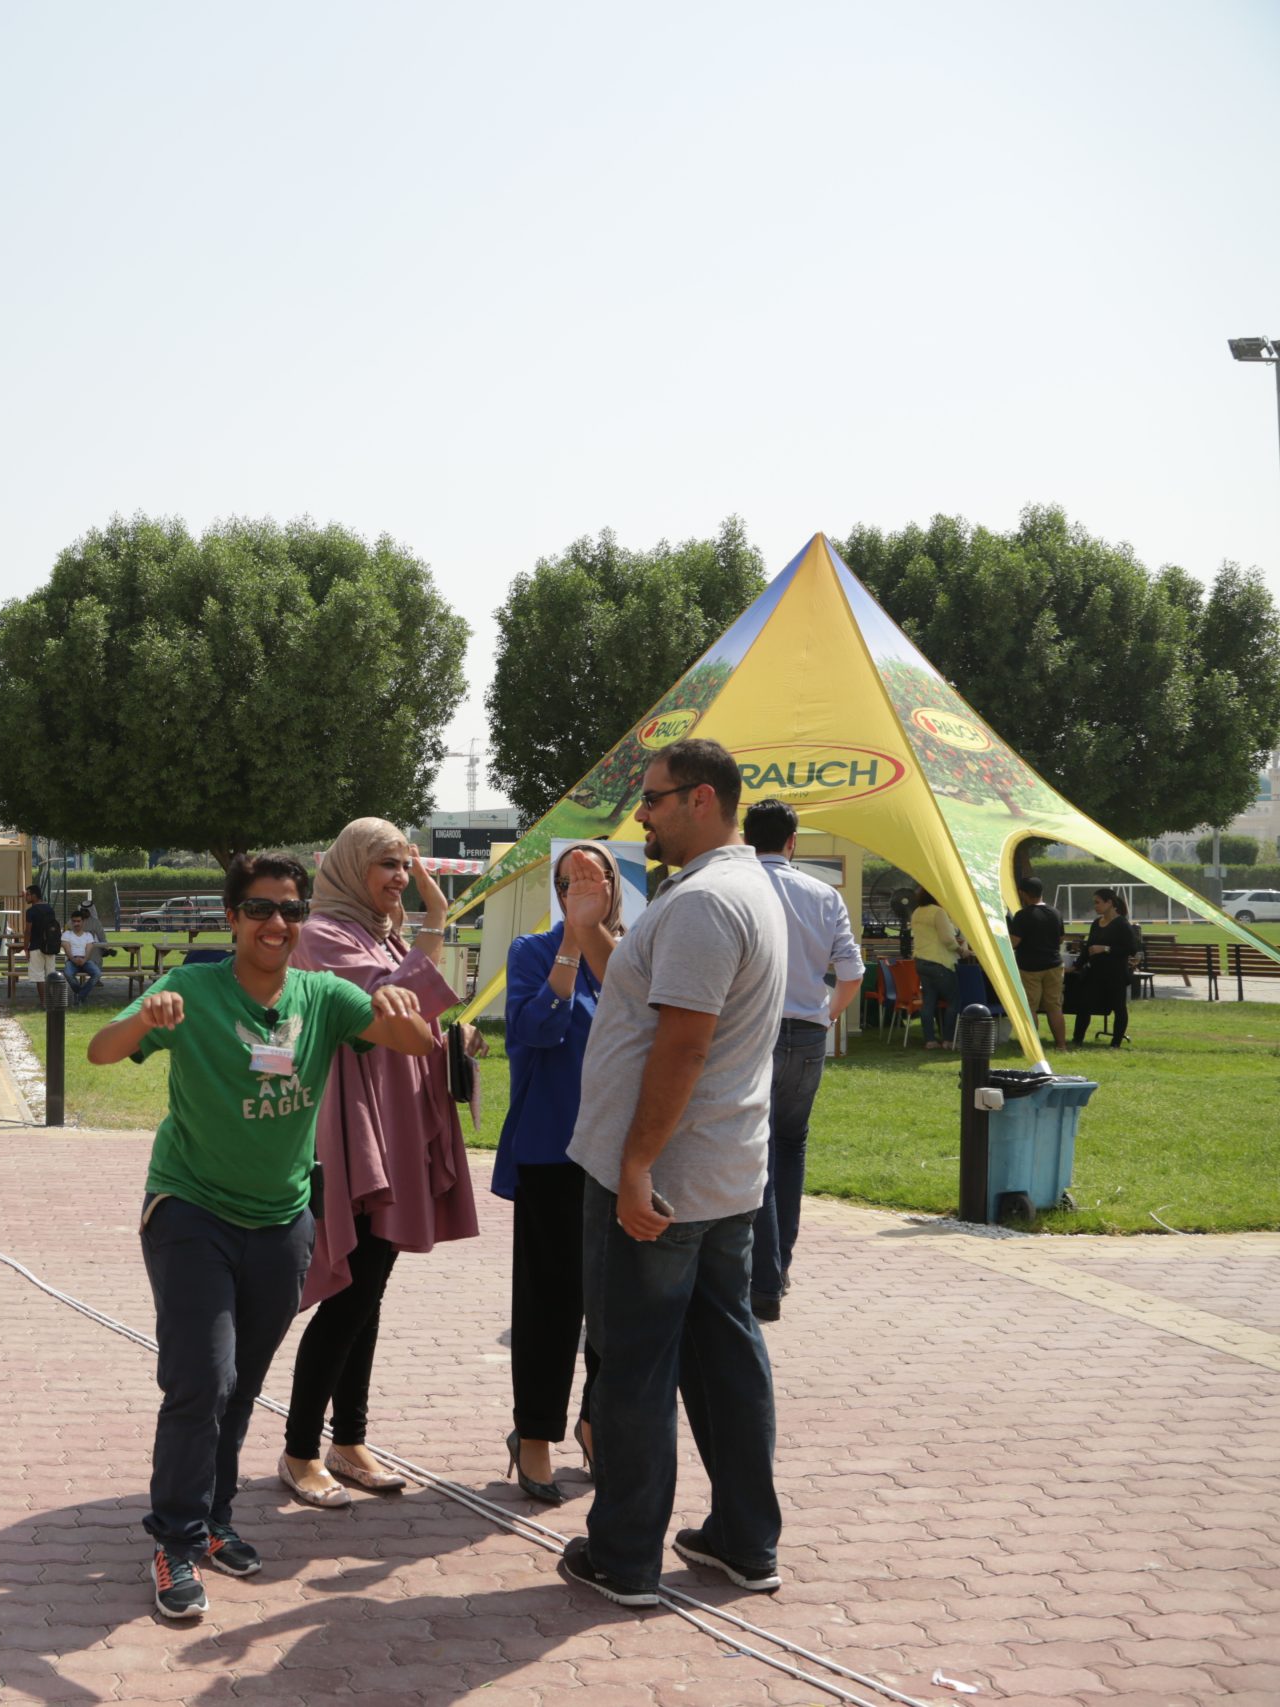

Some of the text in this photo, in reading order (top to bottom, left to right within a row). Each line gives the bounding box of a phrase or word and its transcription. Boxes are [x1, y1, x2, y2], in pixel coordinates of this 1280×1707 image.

[653, 719, 690, 738] RAUCH
[934, 717, 985, 744] RAUCH
[737, 759, 878, 790] RAUCH
[466, 849, 491, 857] PERIOD
[242, 1086, 315, 1120] EAGLE
